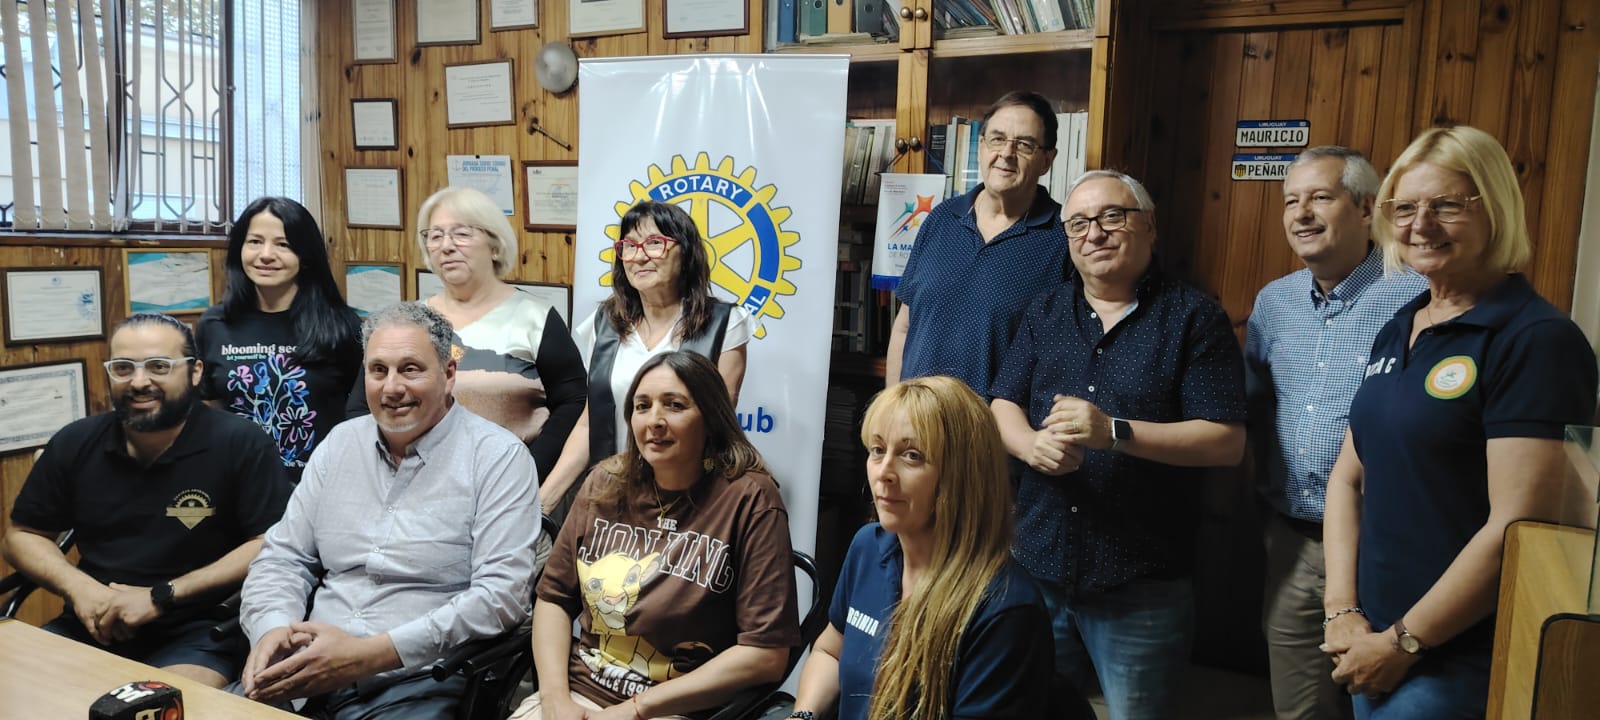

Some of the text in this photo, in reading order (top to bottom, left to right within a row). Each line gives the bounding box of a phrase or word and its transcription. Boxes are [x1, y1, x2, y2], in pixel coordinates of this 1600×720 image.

[1240, 130, 1304, 143] MAURICIO
[1248, 162, 1288, 176] PEÑAR
[658, 175, 744, 200] ROTARY
[900, 243, 913, 251] MA
[743, 295, 767, 314] AL
[221, 342, 276, 356] blooming
[737, 406, 774, 433] ub
[656, 515, 678, 532] THE
[657, 529, 736, 595] KING
[846, 606, 880, 637] RGINIA
